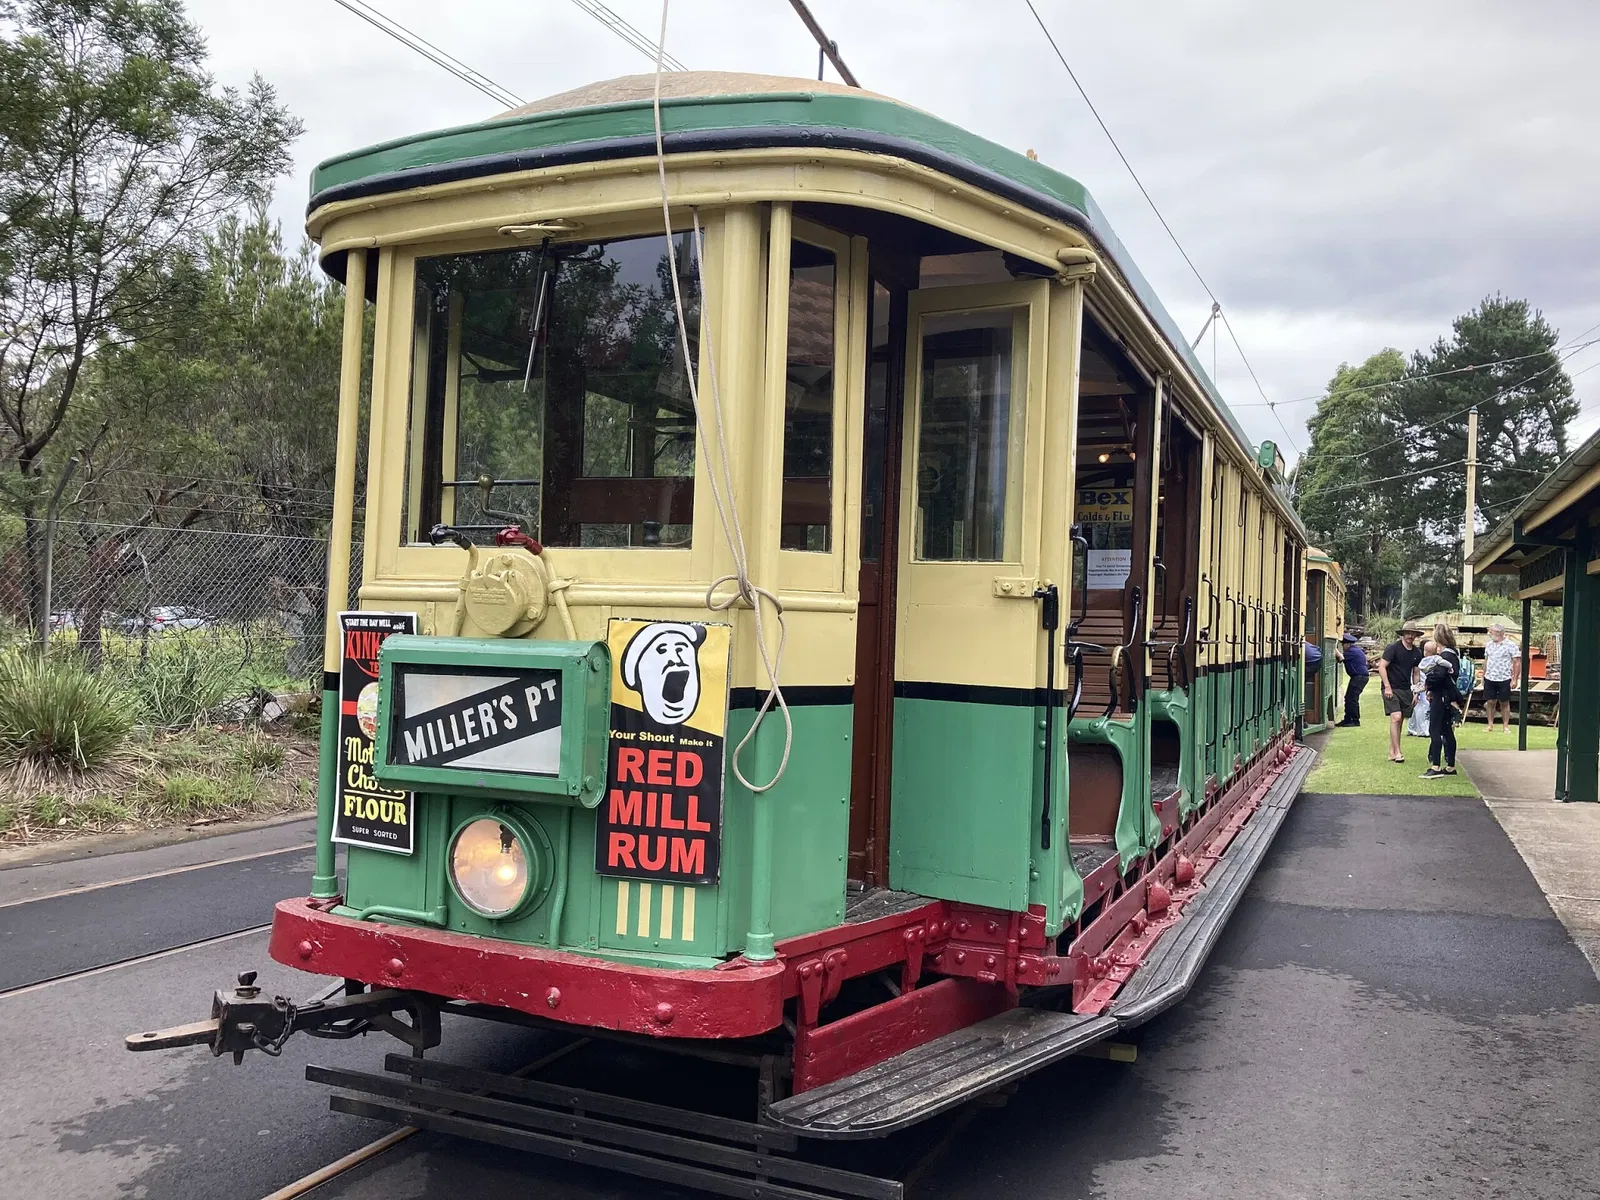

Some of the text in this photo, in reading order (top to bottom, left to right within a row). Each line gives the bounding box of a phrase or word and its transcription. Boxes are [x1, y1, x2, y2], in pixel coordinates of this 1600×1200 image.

[1078, 491, 1130, 506] Bex
[1077, 511, 1130, 521] Colds & Flu
[345, 618, 359, 627] START
[360, 619, 368, 627] THE
[369, 619, 379, 627] DAY
[379, 619, 391, 627] WELL
[345, 630, 389, 660] KINK
[369, 661, 379, 673] TE
[403, 694, 518, 763] MILLER'S
[609, 729, 637, 740] Your
[638, 731, 675, 743] Shout
[679, 738, 704, 747] Make
[617, 747, 704, 787] RED
[344, 795, 407, 825] FLOUR
[608, 789, 711, 832] MILL
[351, 825, 398, 840] SUPER SORTED
[608, 831, 705, 875] RUM
